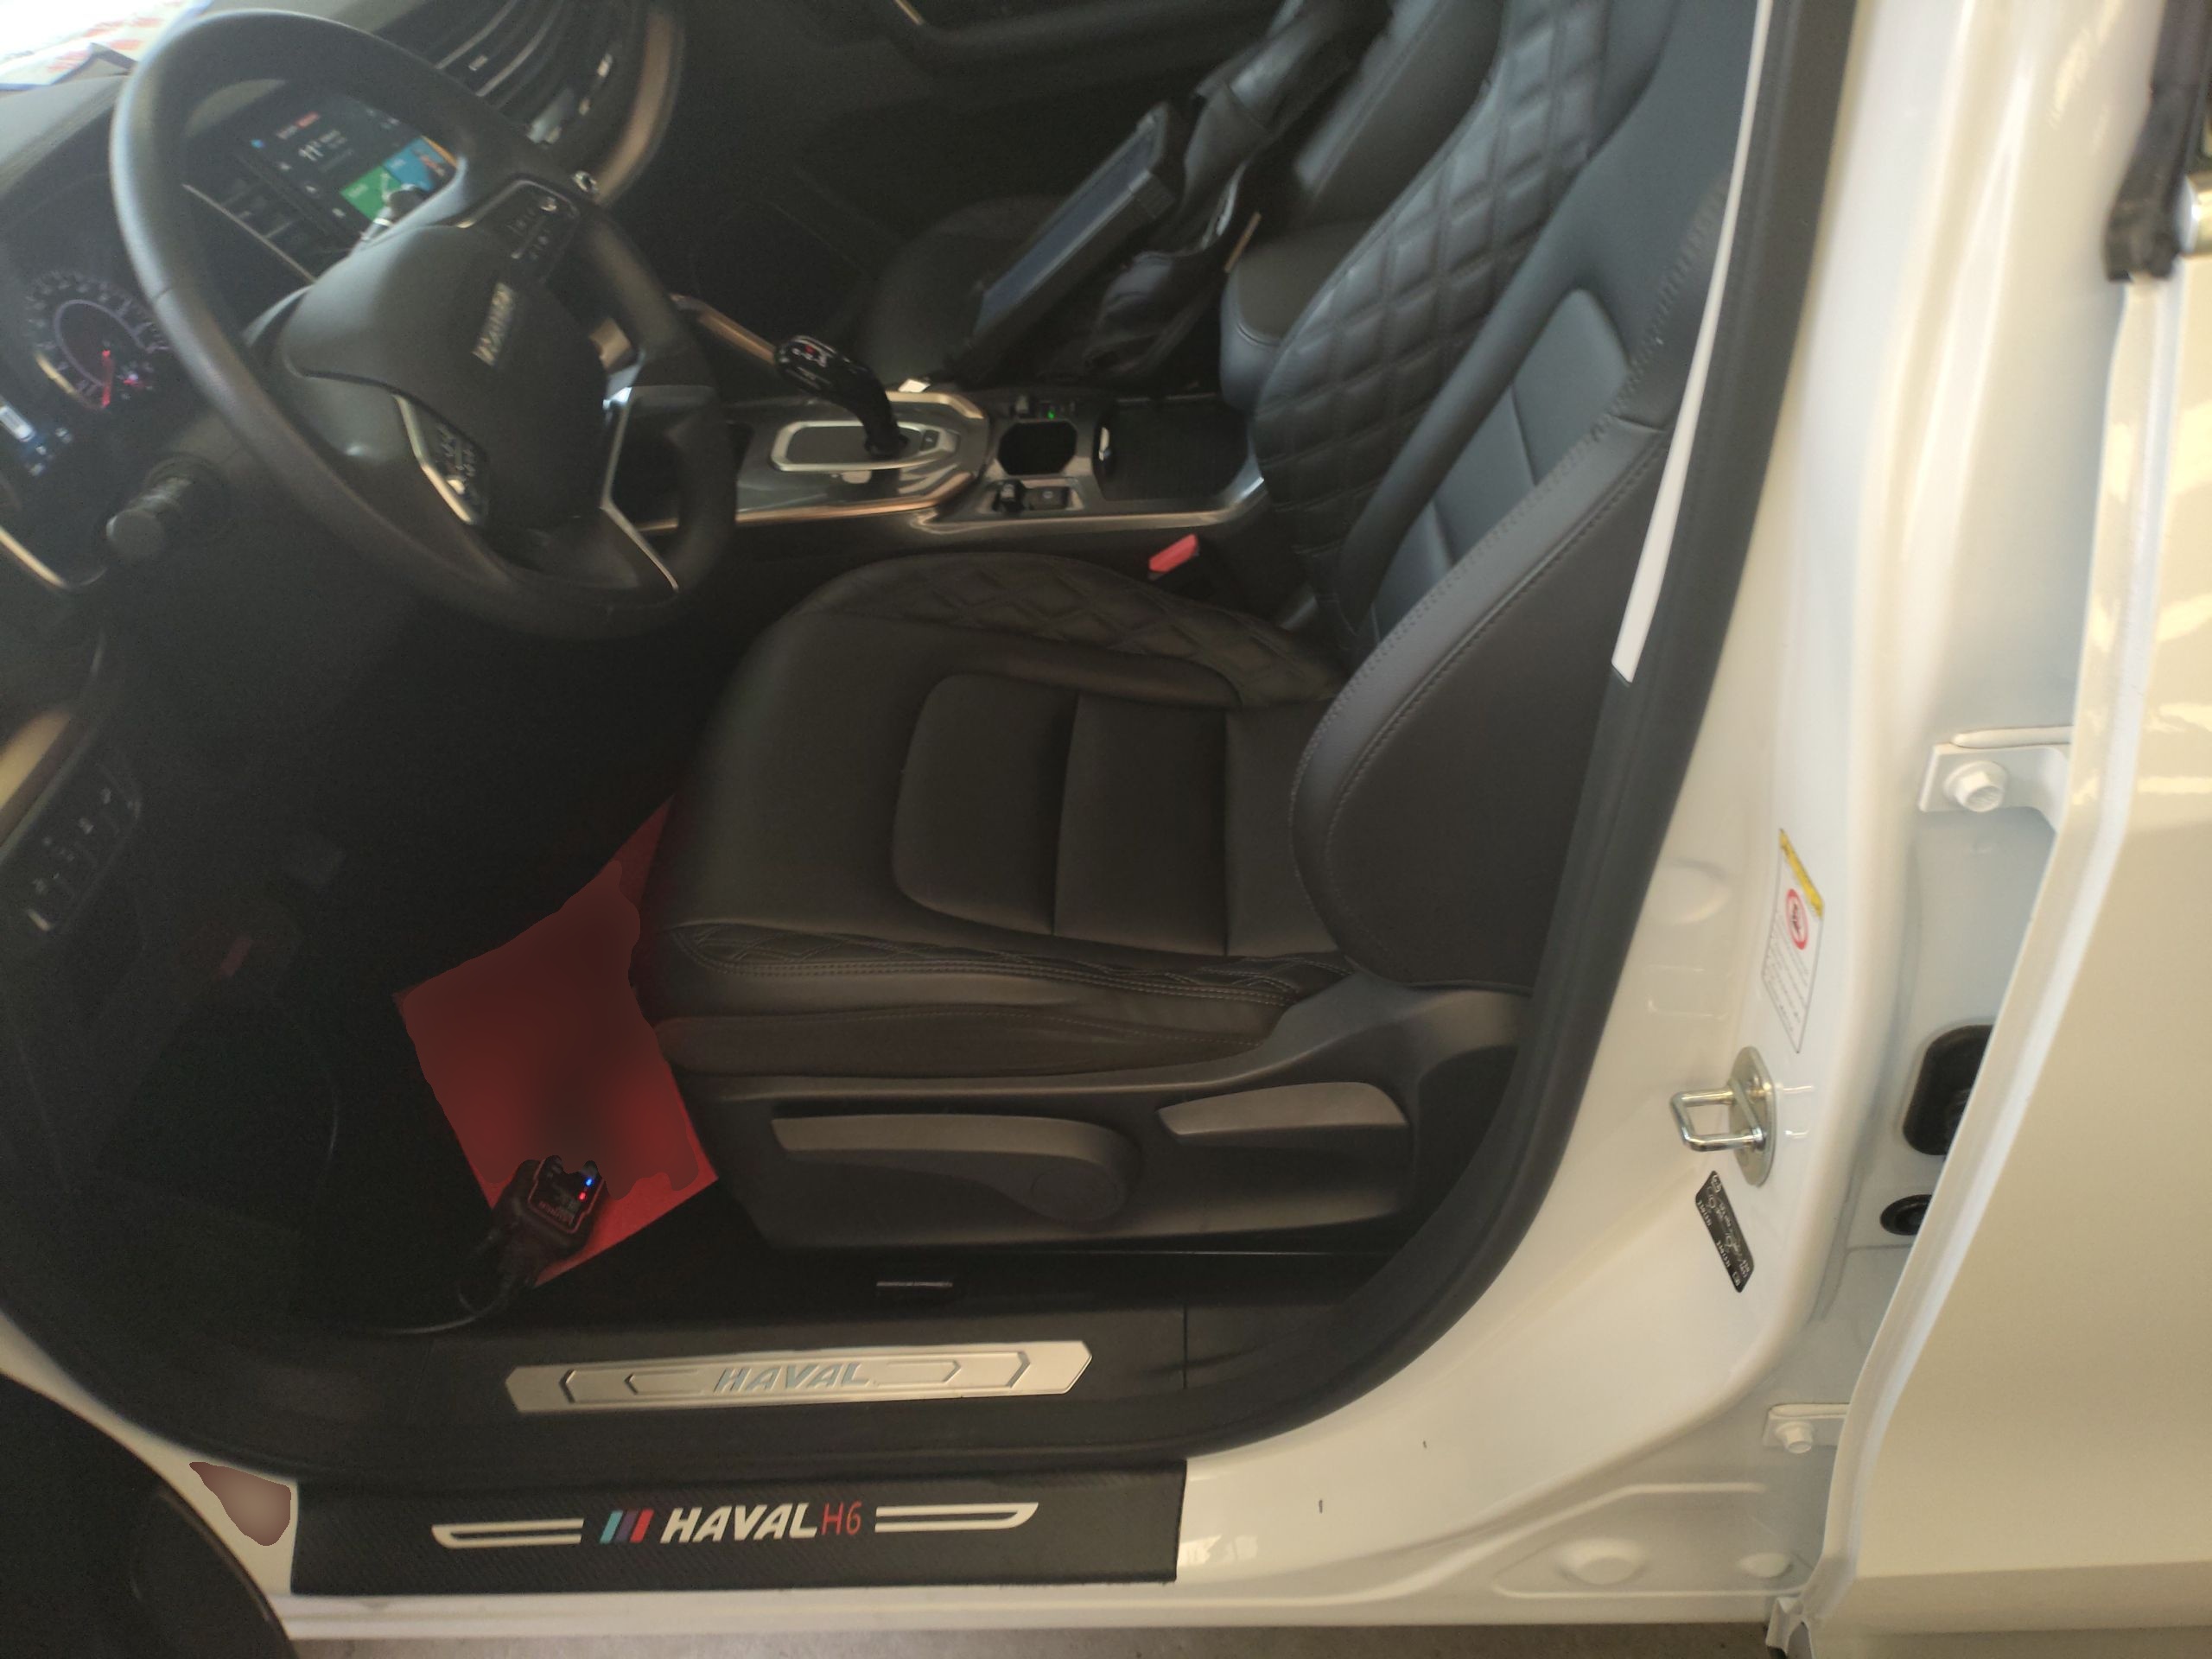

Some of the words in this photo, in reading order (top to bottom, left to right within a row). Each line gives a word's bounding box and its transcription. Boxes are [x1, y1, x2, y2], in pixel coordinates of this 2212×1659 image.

[713, 1362, 870, 1394] HAVAL
[659, 1502, 817, 1544] HAVAL
[821, 1500, 862, 1536] H6
